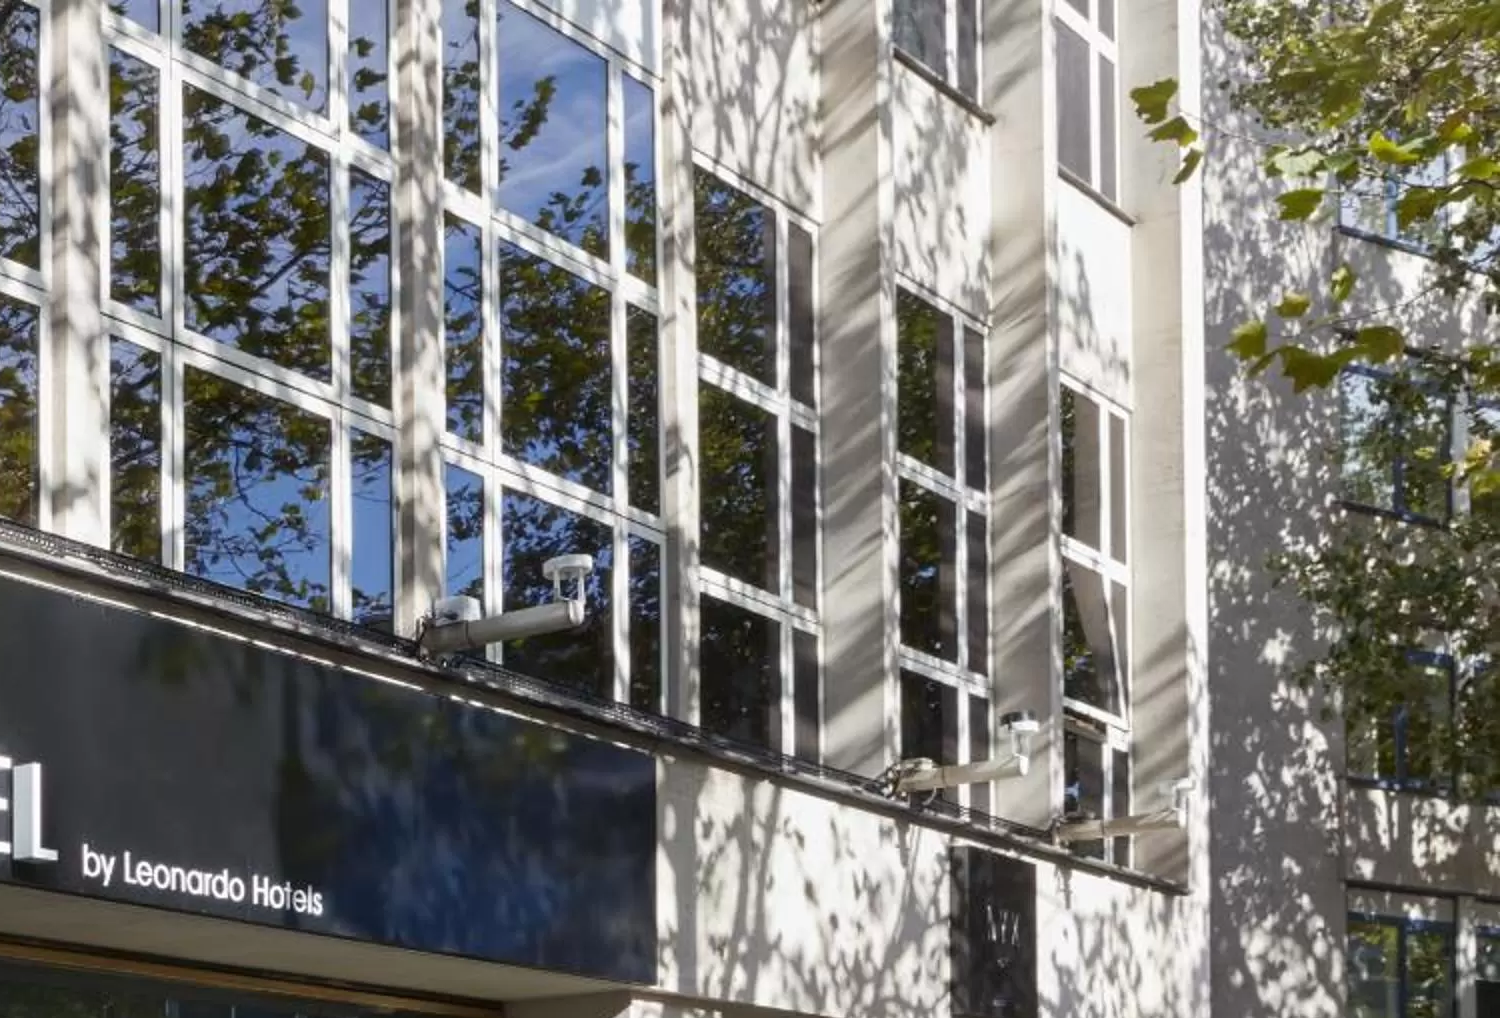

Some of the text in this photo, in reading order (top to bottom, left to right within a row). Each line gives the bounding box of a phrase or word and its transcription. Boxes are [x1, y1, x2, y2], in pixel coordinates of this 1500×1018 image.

[81, 843, 116, 887] by
[123, 851, 245, 901] Leonardo
[252, 874, 323, 916] Hotels
